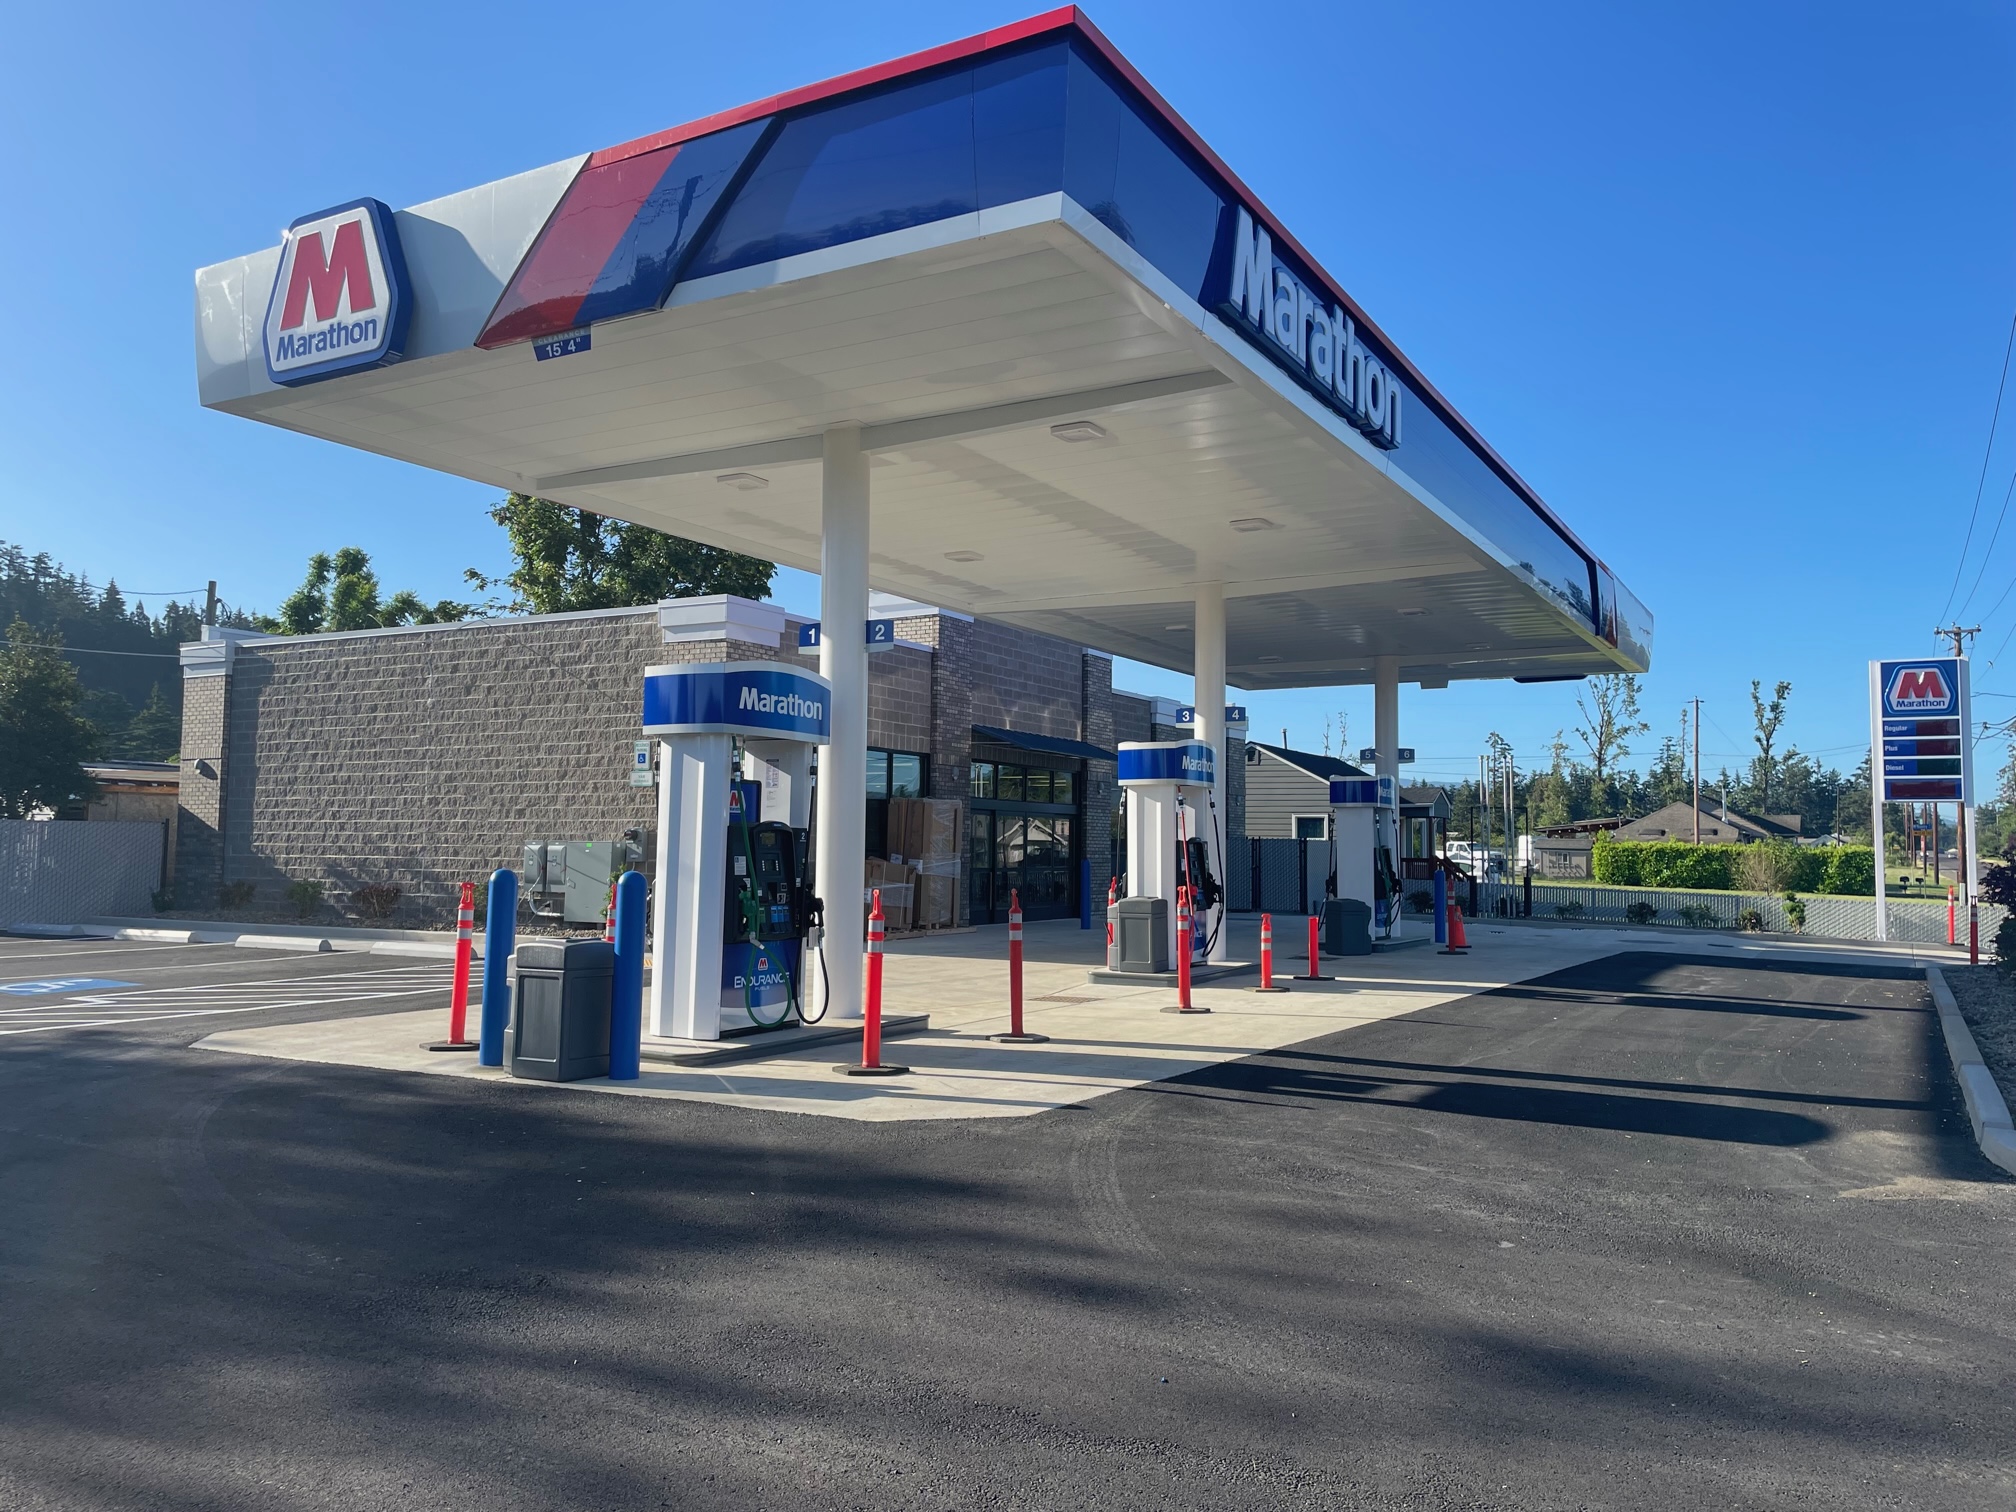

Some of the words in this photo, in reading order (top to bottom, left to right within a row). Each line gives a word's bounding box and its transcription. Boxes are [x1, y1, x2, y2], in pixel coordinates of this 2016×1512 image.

[279, 219, 377, 332] M
[1230, 204, 1402, 445] Marathon
[276, 319, 377, 362] Marathon
[538, 329, 585, 344] CLEARANCE
[546, 341, 563, 358] 15'
[567, 337, 581, 352] 4"
[808, 628, 816, 644] 1
[874, 624, 885, 640] 2
[1896, 671, 1945, 699] M
[739, 686, 823, 721] Marathon
[1896, 699, 1945, 708] Marathon
[1182, 711, 1190, 722] 3
[1231, 709, 1240, 720] 4
[1884, 725, 1908, 733] Regular
[1365, 750, 1371, 759] 5
[1404, 750, 1410, 759] 6
[801, 831, 806, 840] 2
